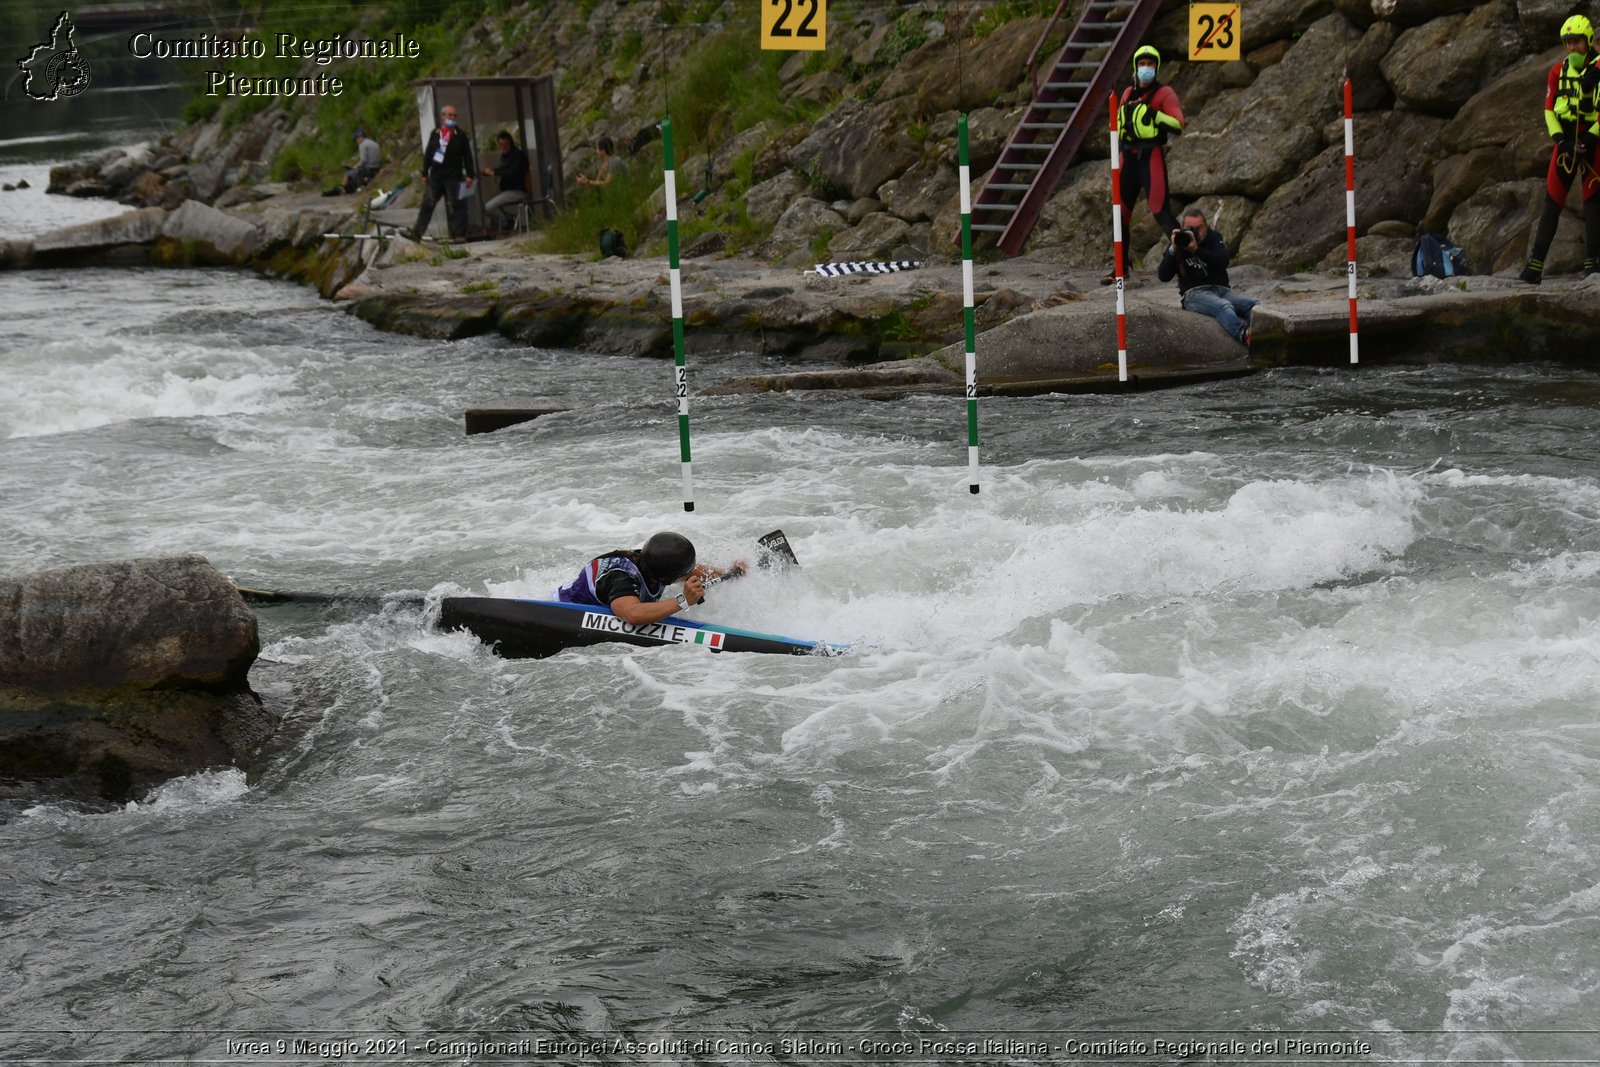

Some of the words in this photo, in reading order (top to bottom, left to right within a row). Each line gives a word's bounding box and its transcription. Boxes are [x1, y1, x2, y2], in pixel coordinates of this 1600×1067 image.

[771, 0, 818, 37] 22
[1196, 14, 1234, 49] 23
[585, 613, 668, 639] MICOZZI
[672, 627, 689, 643] E.
